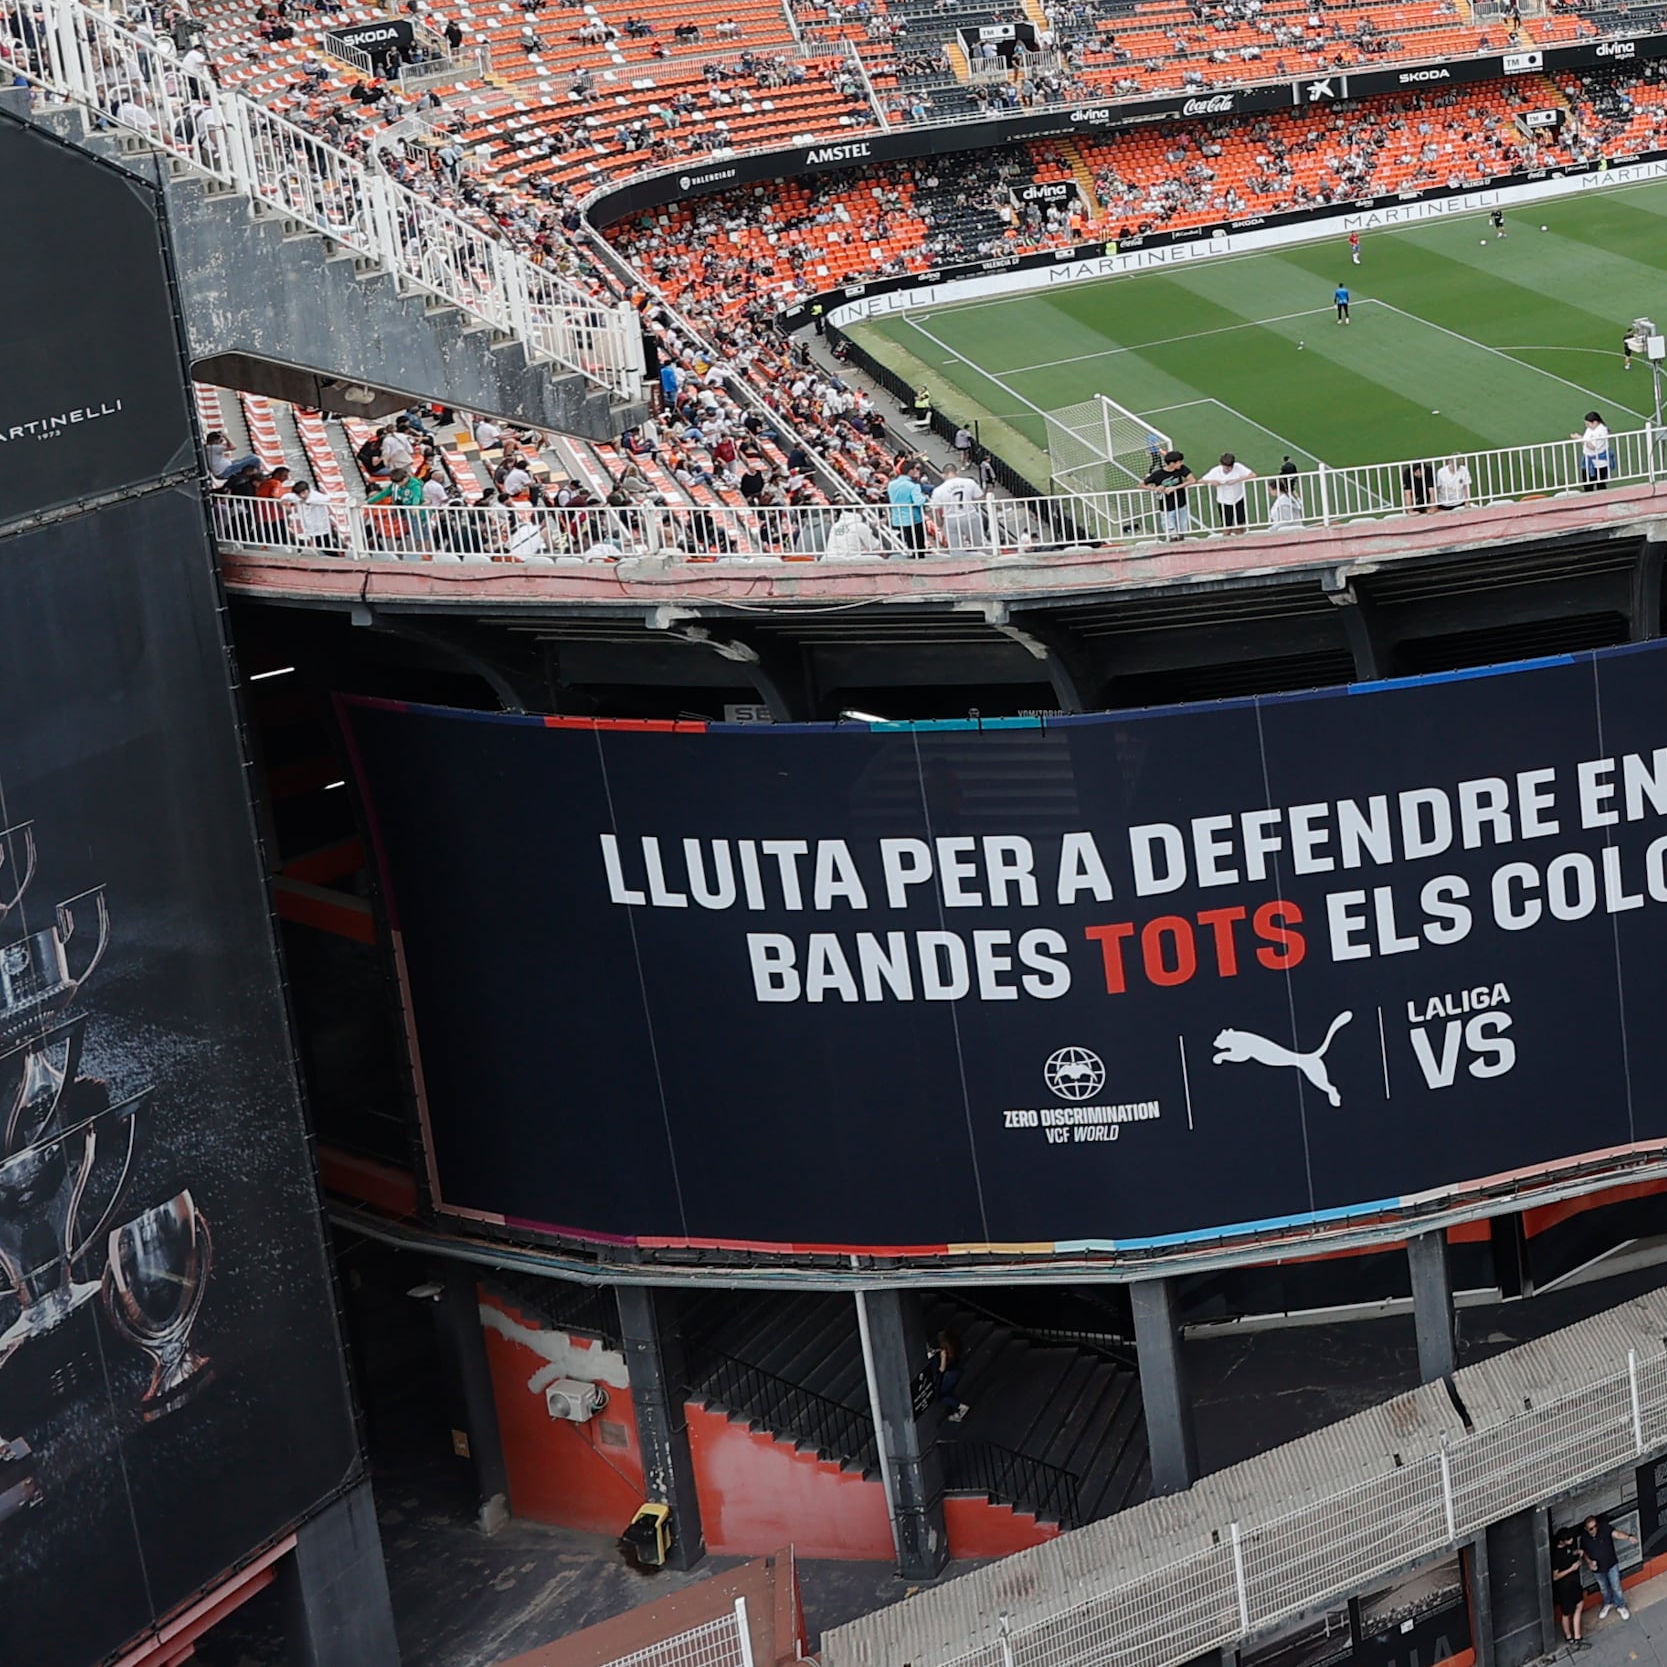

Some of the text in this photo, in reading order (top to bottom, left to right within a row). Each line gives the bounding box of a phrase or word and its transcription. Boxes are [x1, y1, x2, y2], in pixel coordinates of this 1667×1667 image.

[1596, 42, 1634, 56] divina
[1071, 108, 1110, 123] divina
[806, 142, 871, 165] AMSTEL
[1023, 185, 1067, 201] divina
[1344, 192, 1499, 230] MARTINELLI
[1050, 239, 1230, 281] MARTINELLI
[38, 430, 61, 441] 1973
[600, 834, 868, 910] LLUITA
[880, 836, 1039, 909] PER
[1056, 832, 1114, 905] A
[1128, 767, 1560, 898] DEFENDRE
[746, 928, 1072, 1003] BANDES
[1084, 898, 1307, 996] TOTS
[1326, 874, 1473, 963] ELS
[1407, 982, 1511, 1023] LALIGA
[1410, 1010, 1517, 1090] VS
[1003, 1101, 1160, 1130] ZERO DISCRIMINATION
[1045, 1125, 1120, 1144] VCF WORLD
